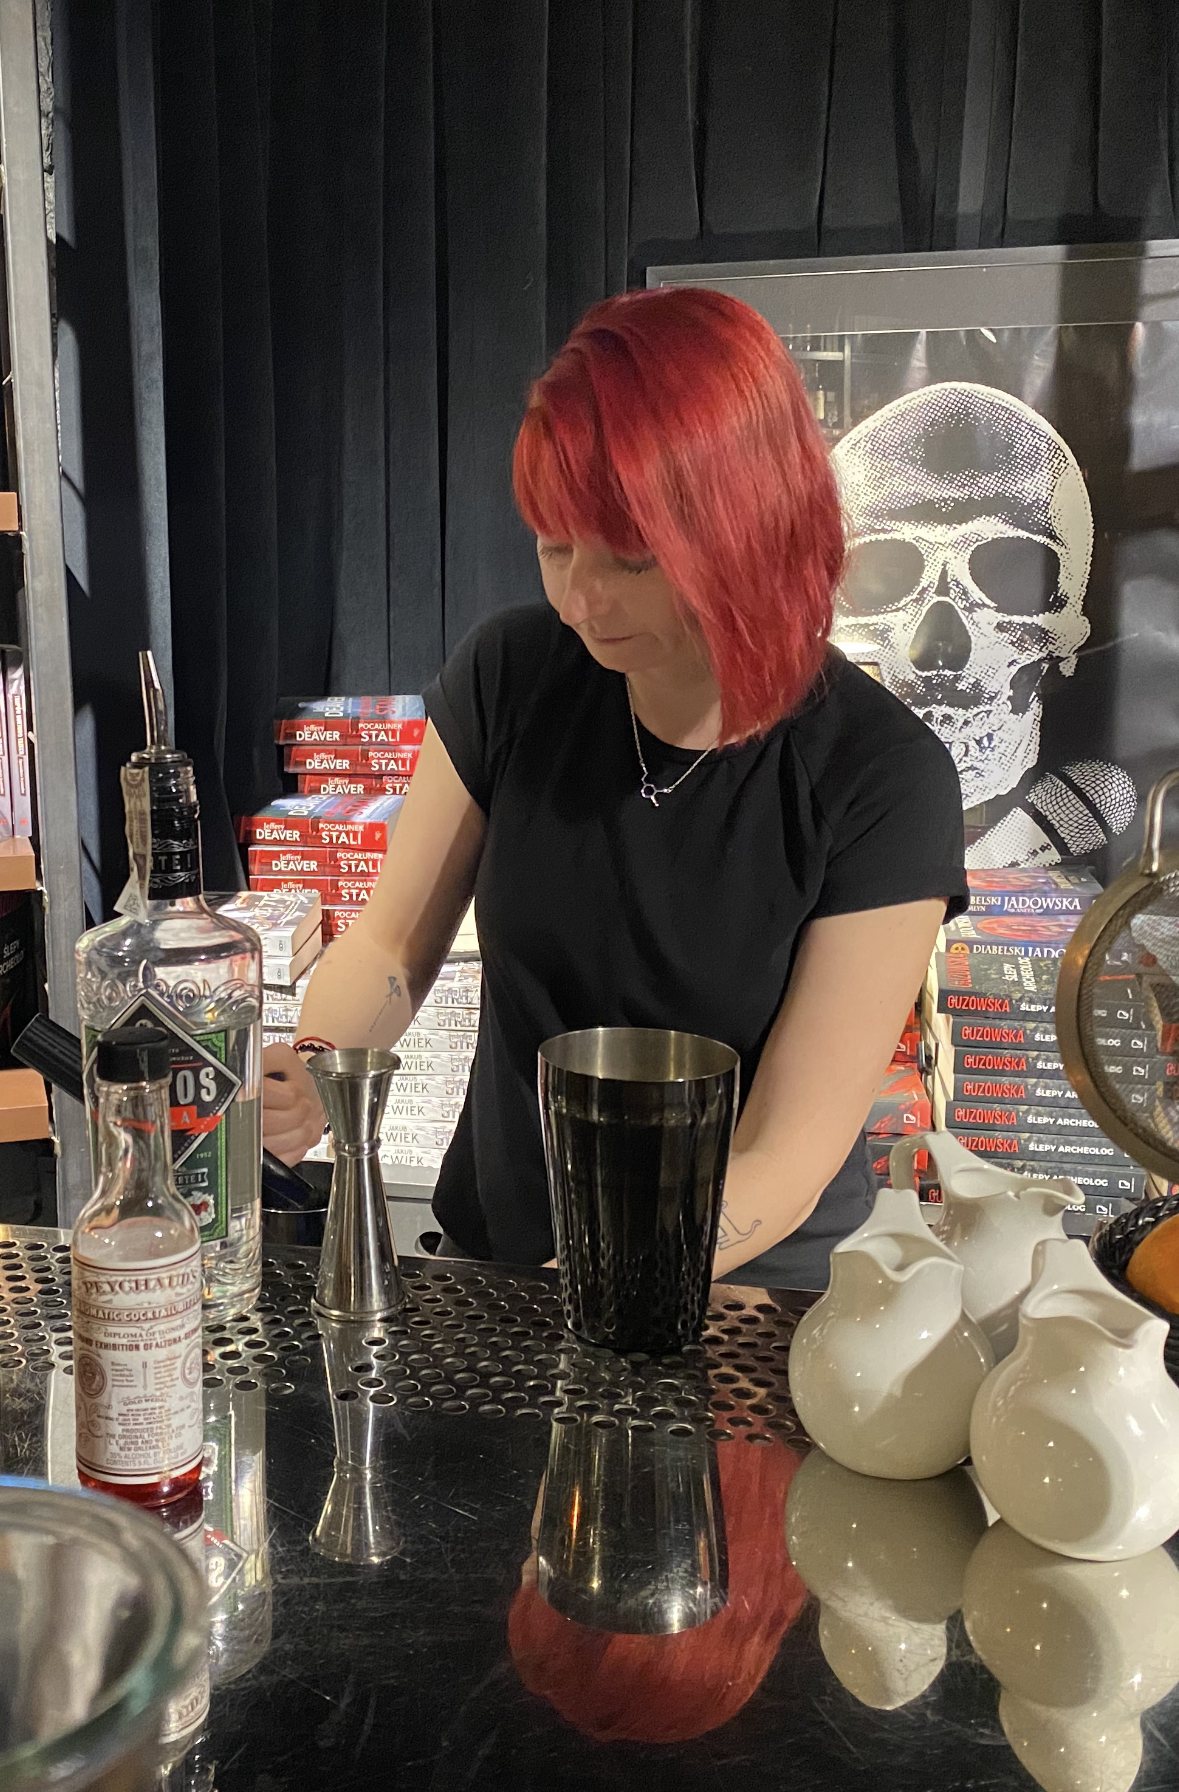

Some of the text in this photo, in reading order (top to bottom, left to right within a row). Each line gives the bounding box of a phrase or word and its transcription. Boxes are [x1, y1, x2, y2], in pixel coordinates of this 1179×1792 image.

[303, 724, 324, 732] Jeffery
[296, 731, 340, 741] DEAVER
[360, 731, 400, 742] STALI
[306, 760, 350, 770] DEAVER
[371, 760, 410, 771] STALI
[320, 784, 364, 794] DEAVER
[385, 784, 410, 794] STA
[264, 822, 285, 830] Jeffery
[319, 823, 364, 831] POCAŁUNEK
[256, 829, 300, 841] DEAVER
[322, 832, 361, 845] STALI
[337, 852, 383, 860] POCAŁUNEK
[272, 860, 318, 871] DEAVER
[340, 861, 381, 872] STALI
[281, 882, 303, 890] Jeffery
[341, 889, 373, 901] STA
[970, 896, 1001, 905] BELSKI
[1003, 897, 1081, 911] JADOWSKA
[973, 945, 1066, 958] DIABELSKI JADO
[947, 995, 1010, 1013] GUZOWSKA
[1020, 1003, 1048, 1012] ŚLEPY
[961, 1026, 1057, 1043] GUZOWSKA ŚLEP
[394, 1038, 433, 1048] WIEK
[401, 1061, 434, 1071] WIEK
[964, 1054, 1064, 1071] GUZOWSKA ŚLEPY
[963, 1082, 1026, 1098] GUZOWSKA
[1035, 1089, 1063, 1098] ŚLEPY
[955, 1108, 1017, 1125] GUZOWSKA
[1027, 1115, 1055, 1125] ŚLEPY
[1028, 1144, 1056, 1153] ŚLEPY
[1058, 1145, 1114, 1155] ARCHEOLOG
[95, 1340, 140, 1352] EXHIBITION
[143, 1342, 152, 1351] OF
